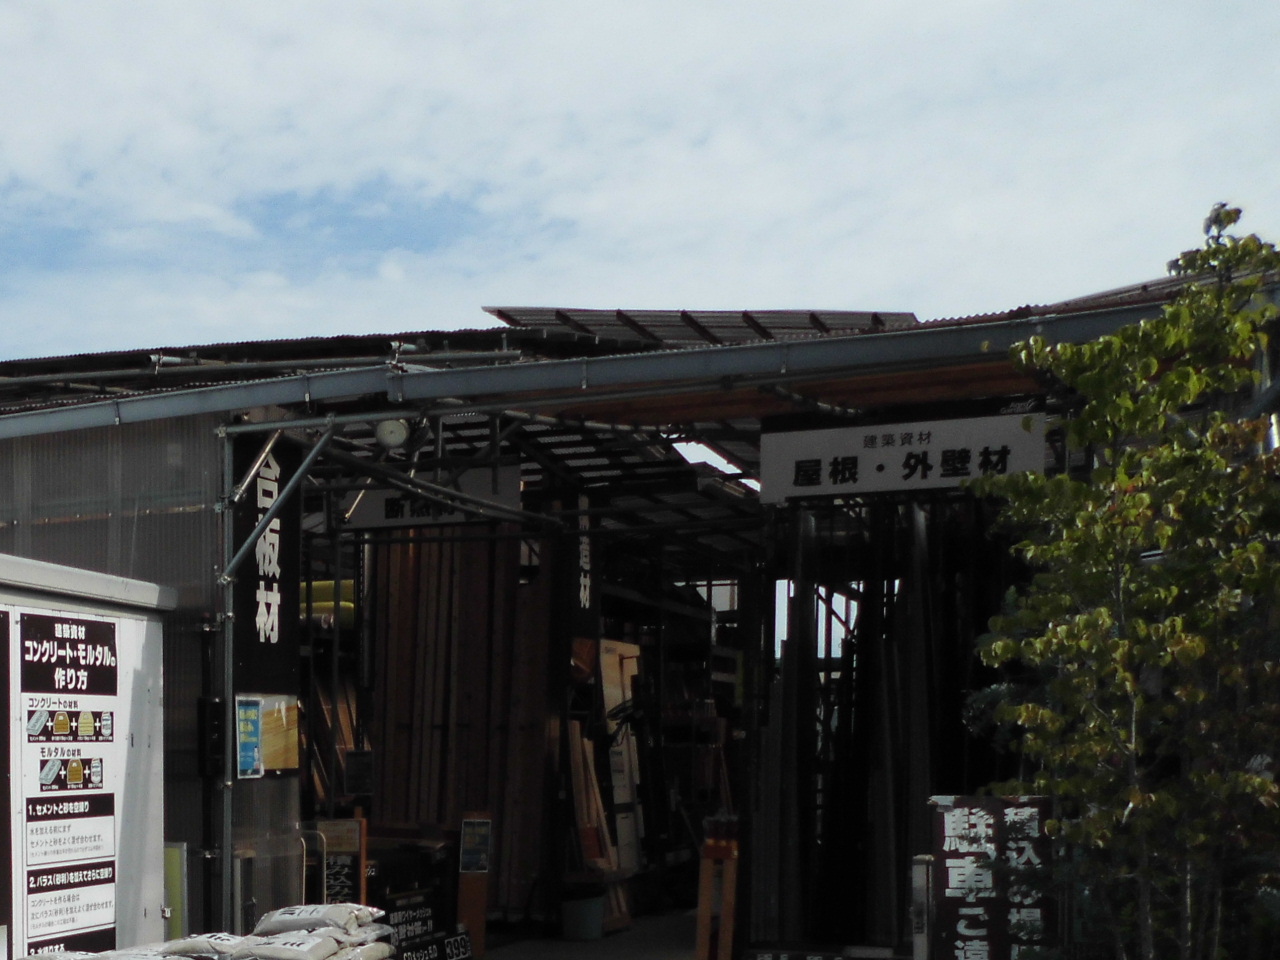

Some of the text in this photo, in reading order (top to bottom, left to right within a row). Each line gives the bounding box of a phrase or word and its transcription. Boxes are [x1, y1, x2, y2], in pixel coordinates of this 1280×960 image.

[863, 431, 932, 448] 建築資材
[793, 445, 1011, 487] 屋根・外壁材
[24, 640, 116, 666] コンクリート・モルタルの
[54, 667, 88, 690] 作り方
[28, 698, 78, 709] コンクリートの材料
[40, 747, 82, 758] モルタルの材料
[446, 937, 468, 960] 399
